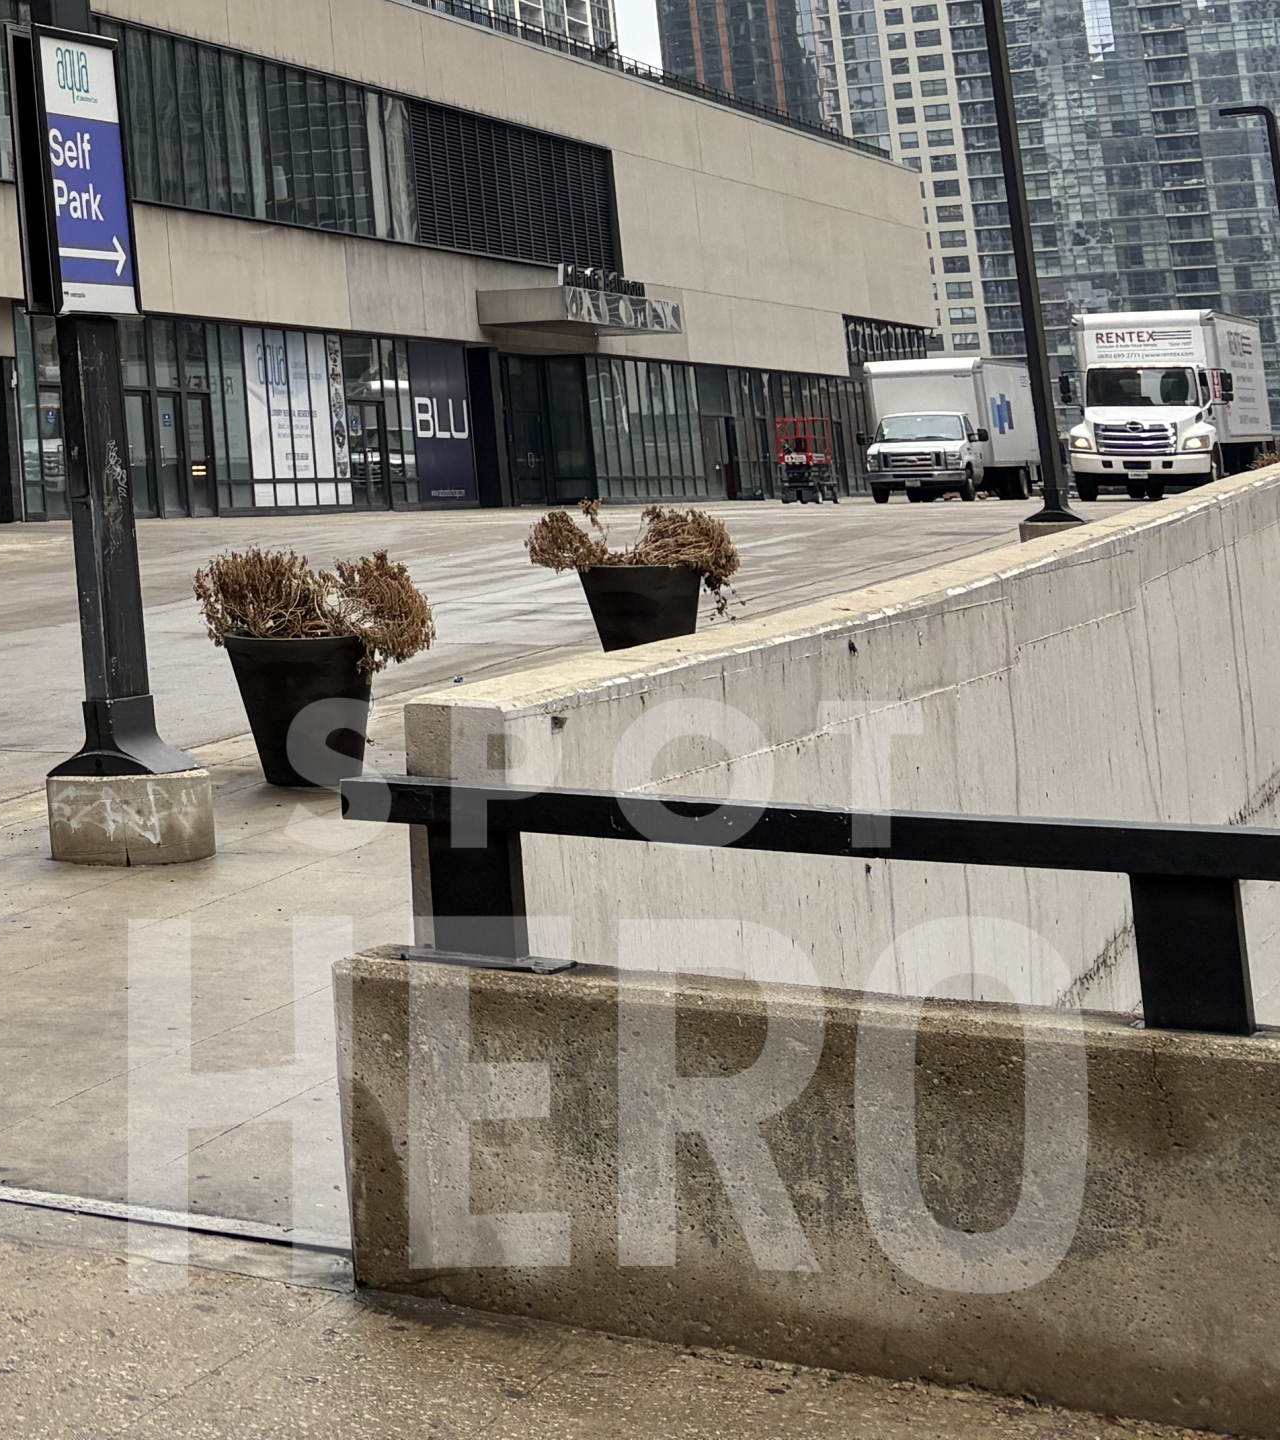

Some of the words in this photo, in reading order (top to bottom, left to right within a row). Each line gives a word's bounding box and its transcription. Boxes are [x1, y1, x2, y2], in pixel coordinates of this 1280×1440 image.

[55, 47, 90, 103] aqua
[49, 128, 91, 170] Self
[53, 179, 104, 221] Park
[1095, 330, 1156, 344] RENTEX
[414, 396, 469, 439] BLU
